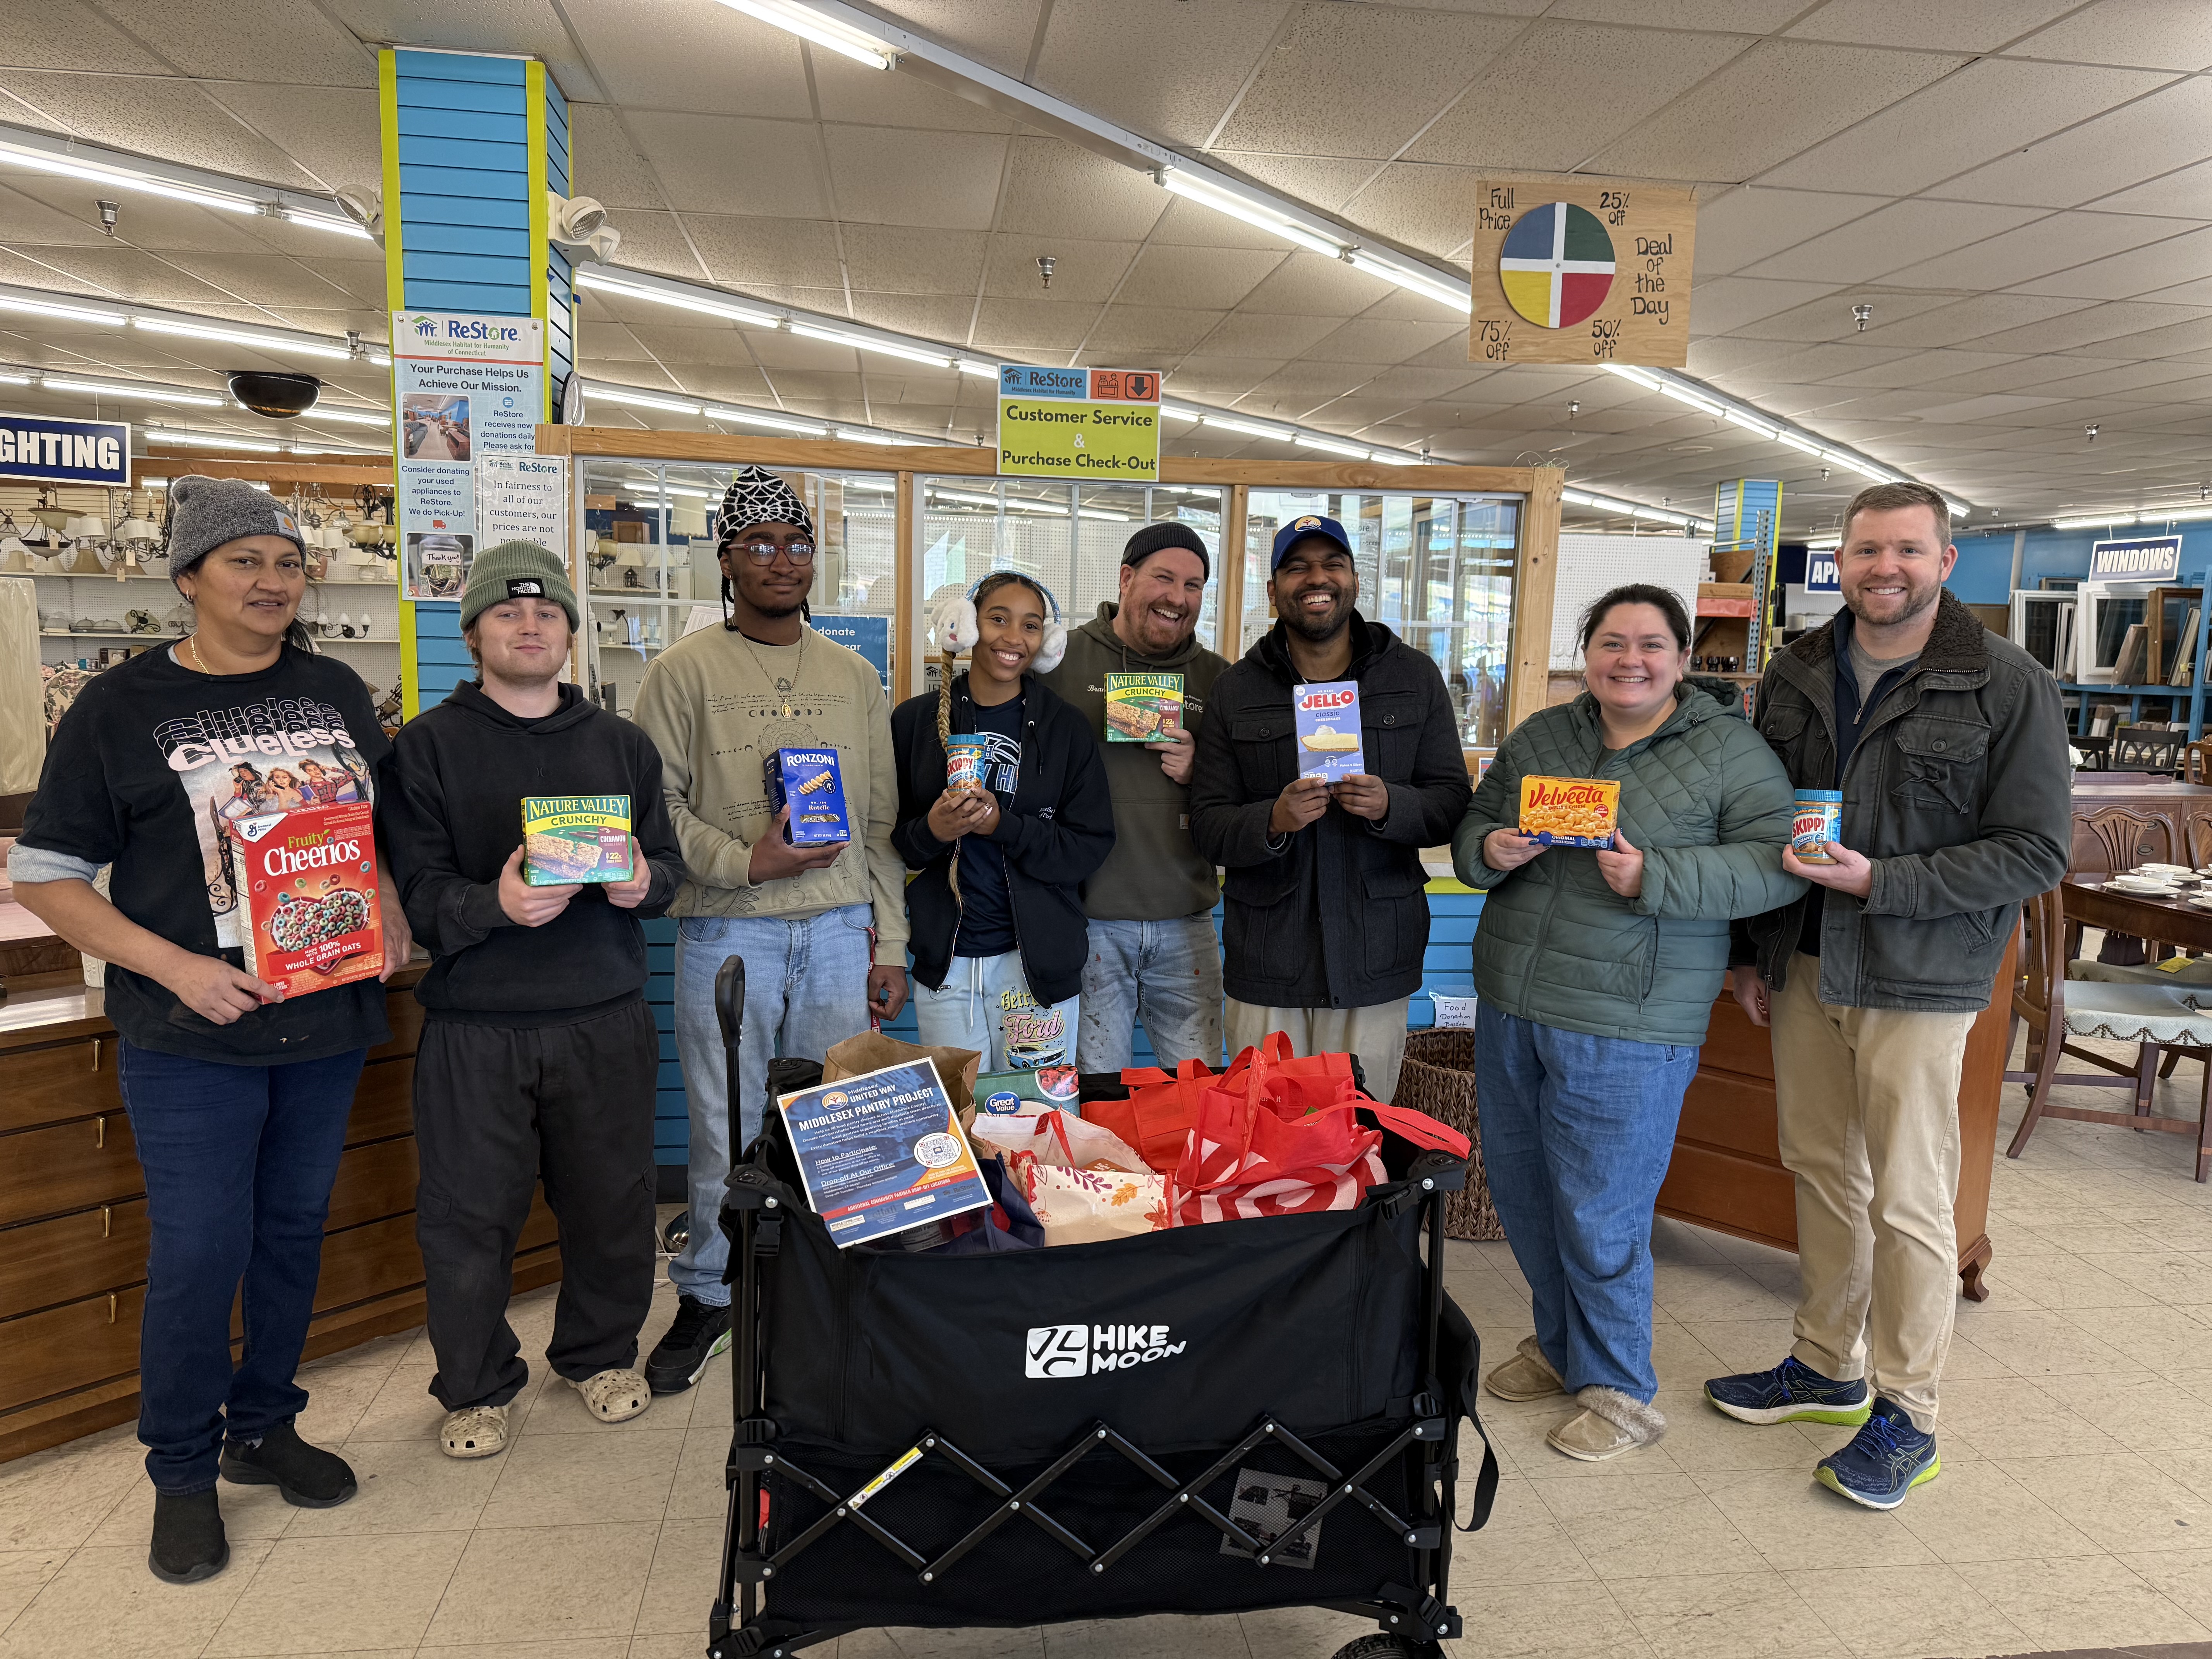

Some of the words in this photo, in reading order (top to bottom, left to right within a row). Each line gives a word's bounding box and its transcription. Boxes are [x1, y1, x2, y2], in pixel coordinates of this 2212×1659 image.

[1491, 188, 1514, 209] Full
[1600, 192, 1630, 209] 25%
[1479, 208, 1510, 230] Price
[1635, 234, 1673, 256] Deal
[1635, 273, 1665, 293] the
[1630, 297, 1669, 325] Day
[448, 320, 518, 341] ReStore
[1478, 320, 1512, 342] 75%
[1592, 319, 1621, 338] 50%
[410, 364, 434, 374] Your
[436, 365, 483, 376] Purchase
[486, 368, 514, 378] Helps
[516, 370, 529, 378] Us
[1030, 371, 1082, 388] ReStore
[419, 379, 458, 388] Achieve
[460, 381, 479, 390] Our
[482, 382, 521, 392] Mission.
[1006, 405, 1087, 423] Customer
[1092, 410, 1152, 426] Service
[518, 432, 534, 441] daily
[1074, 433, 1085, 448] &
[519, 462, 557, 474] ReStore
[1002, 450, 1071, 466] Purchase
[1075, 454, 1155, 470] Check-Out
[436, 467, 469, 476] donating
[412, 488, 451, 497] appliances
[505, 481, 540, 491] fairness
[503, 495, 513, 503] all
[434, 509, 465, 517] Pick-Up!
[489, 510, 538, 519] customers,
[493, 522, 519, 532] prices
[500, 538, 546, 546] neble
[2097, 547, 2174, 573] WINDOWS
[818, 627, 855, 636] donate
[1111, 676, 1146, 690] NATURE
[1147, 676, 1180, 691] VALLEY
[1183, 700, 1203, 713] tore
[787, 754, 835, 766] RONZONI
[1528, 783, 1604, 808] Velveeta
[529, 800, 580, 820] NATURE
[581, 799, 625, 817] VALLEY
[551, 816, 607, 826] CRUNCHY
[1793, 817, 1825, 838] SKIPPY
[288, 832, 324, 849] Fruity
[1797, 836, 1812, 845] CREAMY
[264, 839, 361, 876] Cheerios
[319, 940, 340, 953] 100%
[285, 957, 314, 970] WHOLE
[316, 948, 340, 961] GRAIN
[342, 942, 361, 952] OATS
[1001, 990, 1040, 1012] Detr
[1444, 1002, 1466, 1010] Food
[1004, 1010, 1064, 1045] Ford
[848, 1084, 878, 1094] Middlesex
[850, 1090, 878, 1103] UNITED
[879, 1084, 896, 1094] WAY
[799, 1109, 854, 1131] MIDDLESEX
[855, 1098, 890, 1116] PANTRY
[892, 1087, 933, 1106] PROJECT
[989, 1097, 1015, 1106] Great
[821, 1174, 849, 1187] Drop-off
[953, 1183, 975, 1193] ReStore
[848, 1202, 870, 1211] ADDITIONAL
[871, 1194, 894, 1204] COMMUNITY
[894, 1189, 911, 1198] PARTNER
[911, 1185, 929, 1193] DROP-OFF
[931, 1178, 951, 1188] LOCATIONS
[1093, 1324, 1170, 1351] HIKE
[1092, 1341, 1187, 1374] MOON
